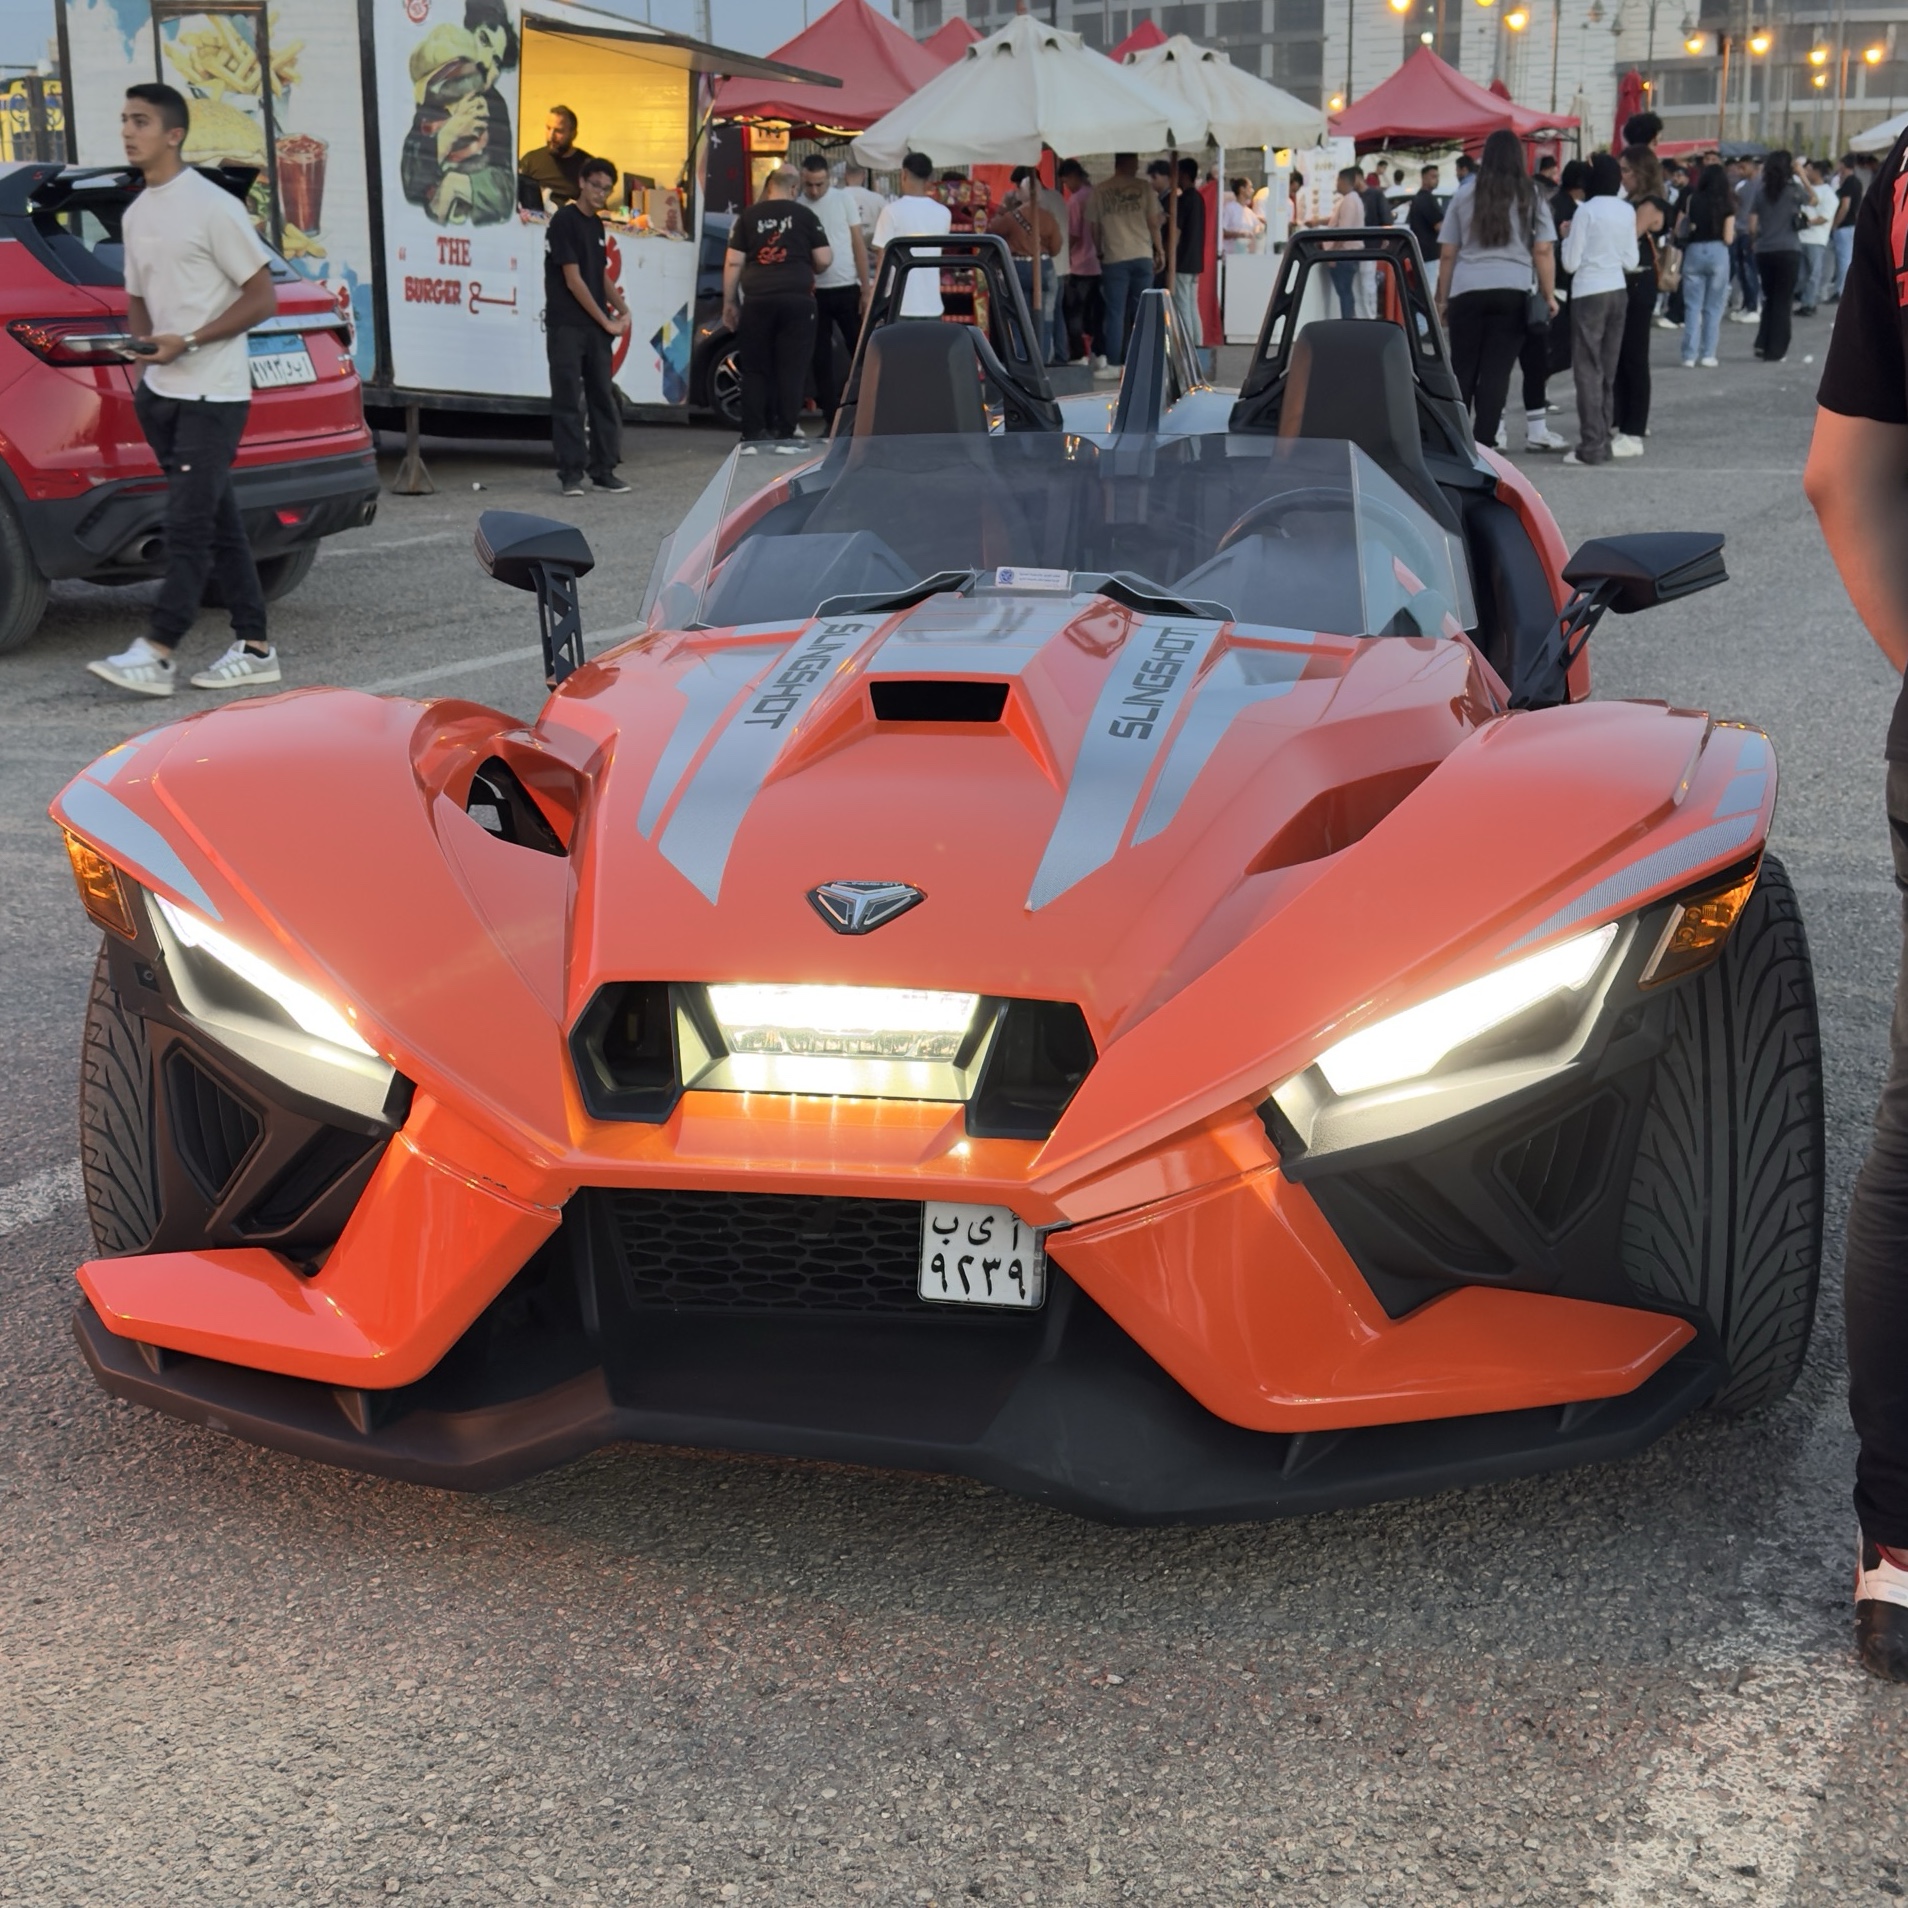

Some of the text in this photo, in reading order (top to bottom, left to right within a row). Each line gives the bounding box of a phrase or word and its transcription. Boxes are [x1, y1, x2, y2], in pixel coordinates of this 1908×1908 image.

[436, 236, 472, 267] THE
[404, 276, 462, 305] BURGER
[744, 623, 864, 729] SLINGSHOT
[1108, 627, 1199, 740] SLINGSHOT
[930, 1252, 1026, 1300] ٩٢٣٩
